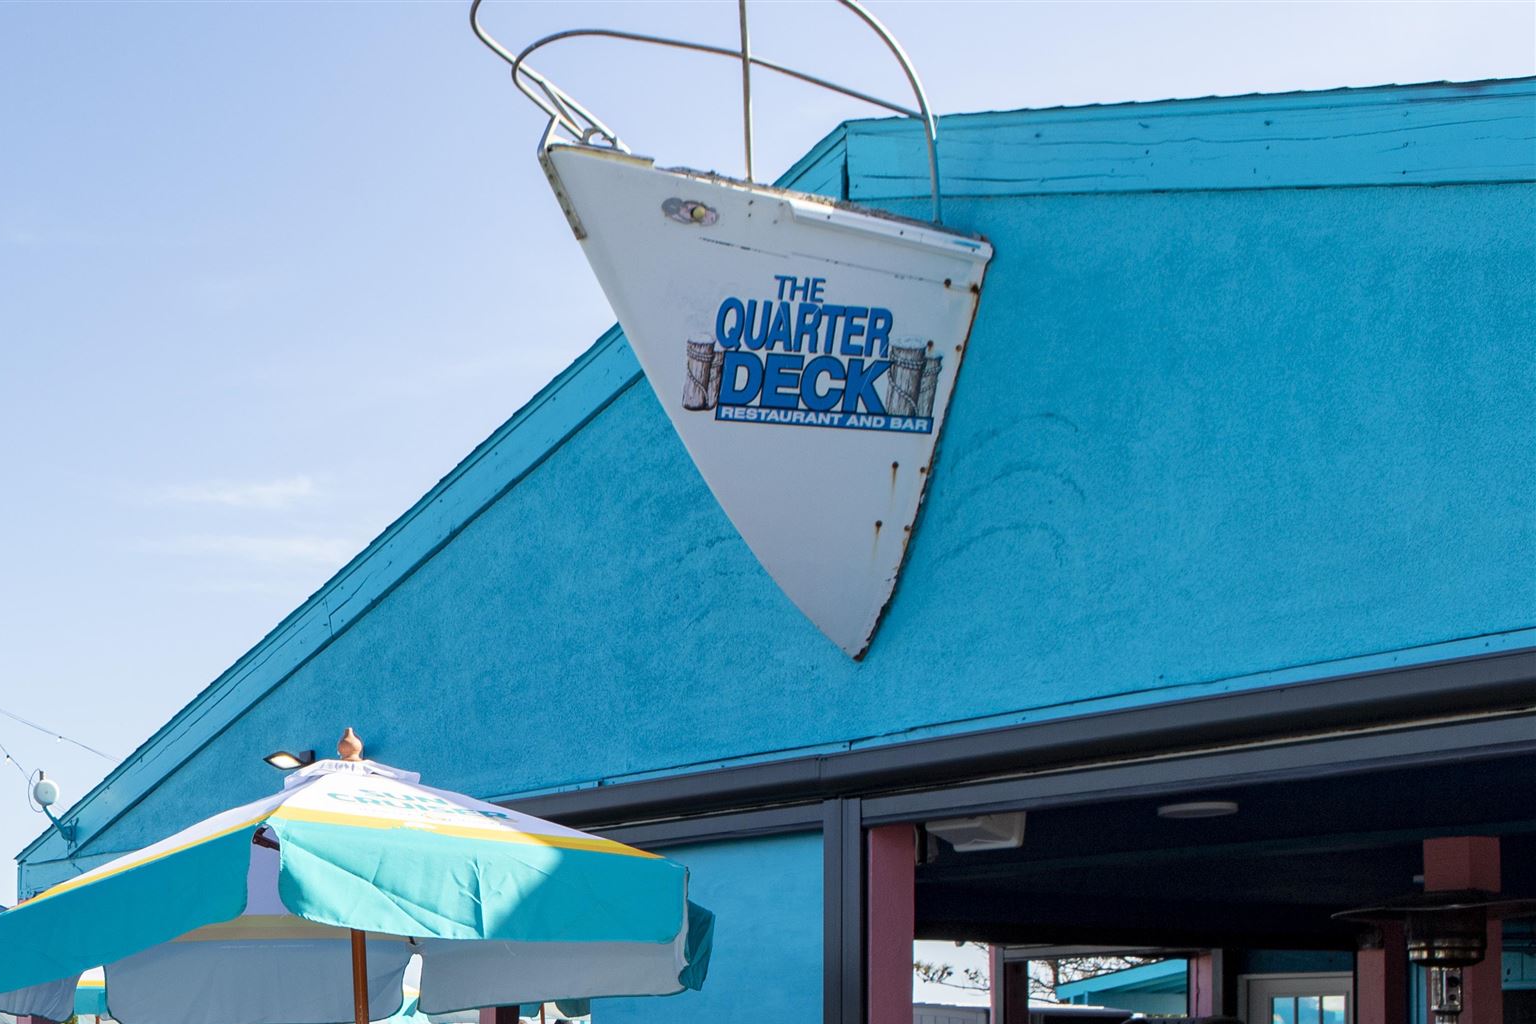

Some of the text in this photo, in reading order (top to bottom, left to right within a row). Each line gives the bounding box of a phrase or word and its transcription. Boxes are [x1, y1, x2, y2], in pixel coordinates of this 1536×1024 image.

[774, 274, 826, 303] THE
[715, 297, 893, 358] QUARTER
[717, 351, 895, 414] DECK
[720, 406, 929, 432] RESTAURANT AND BAR
